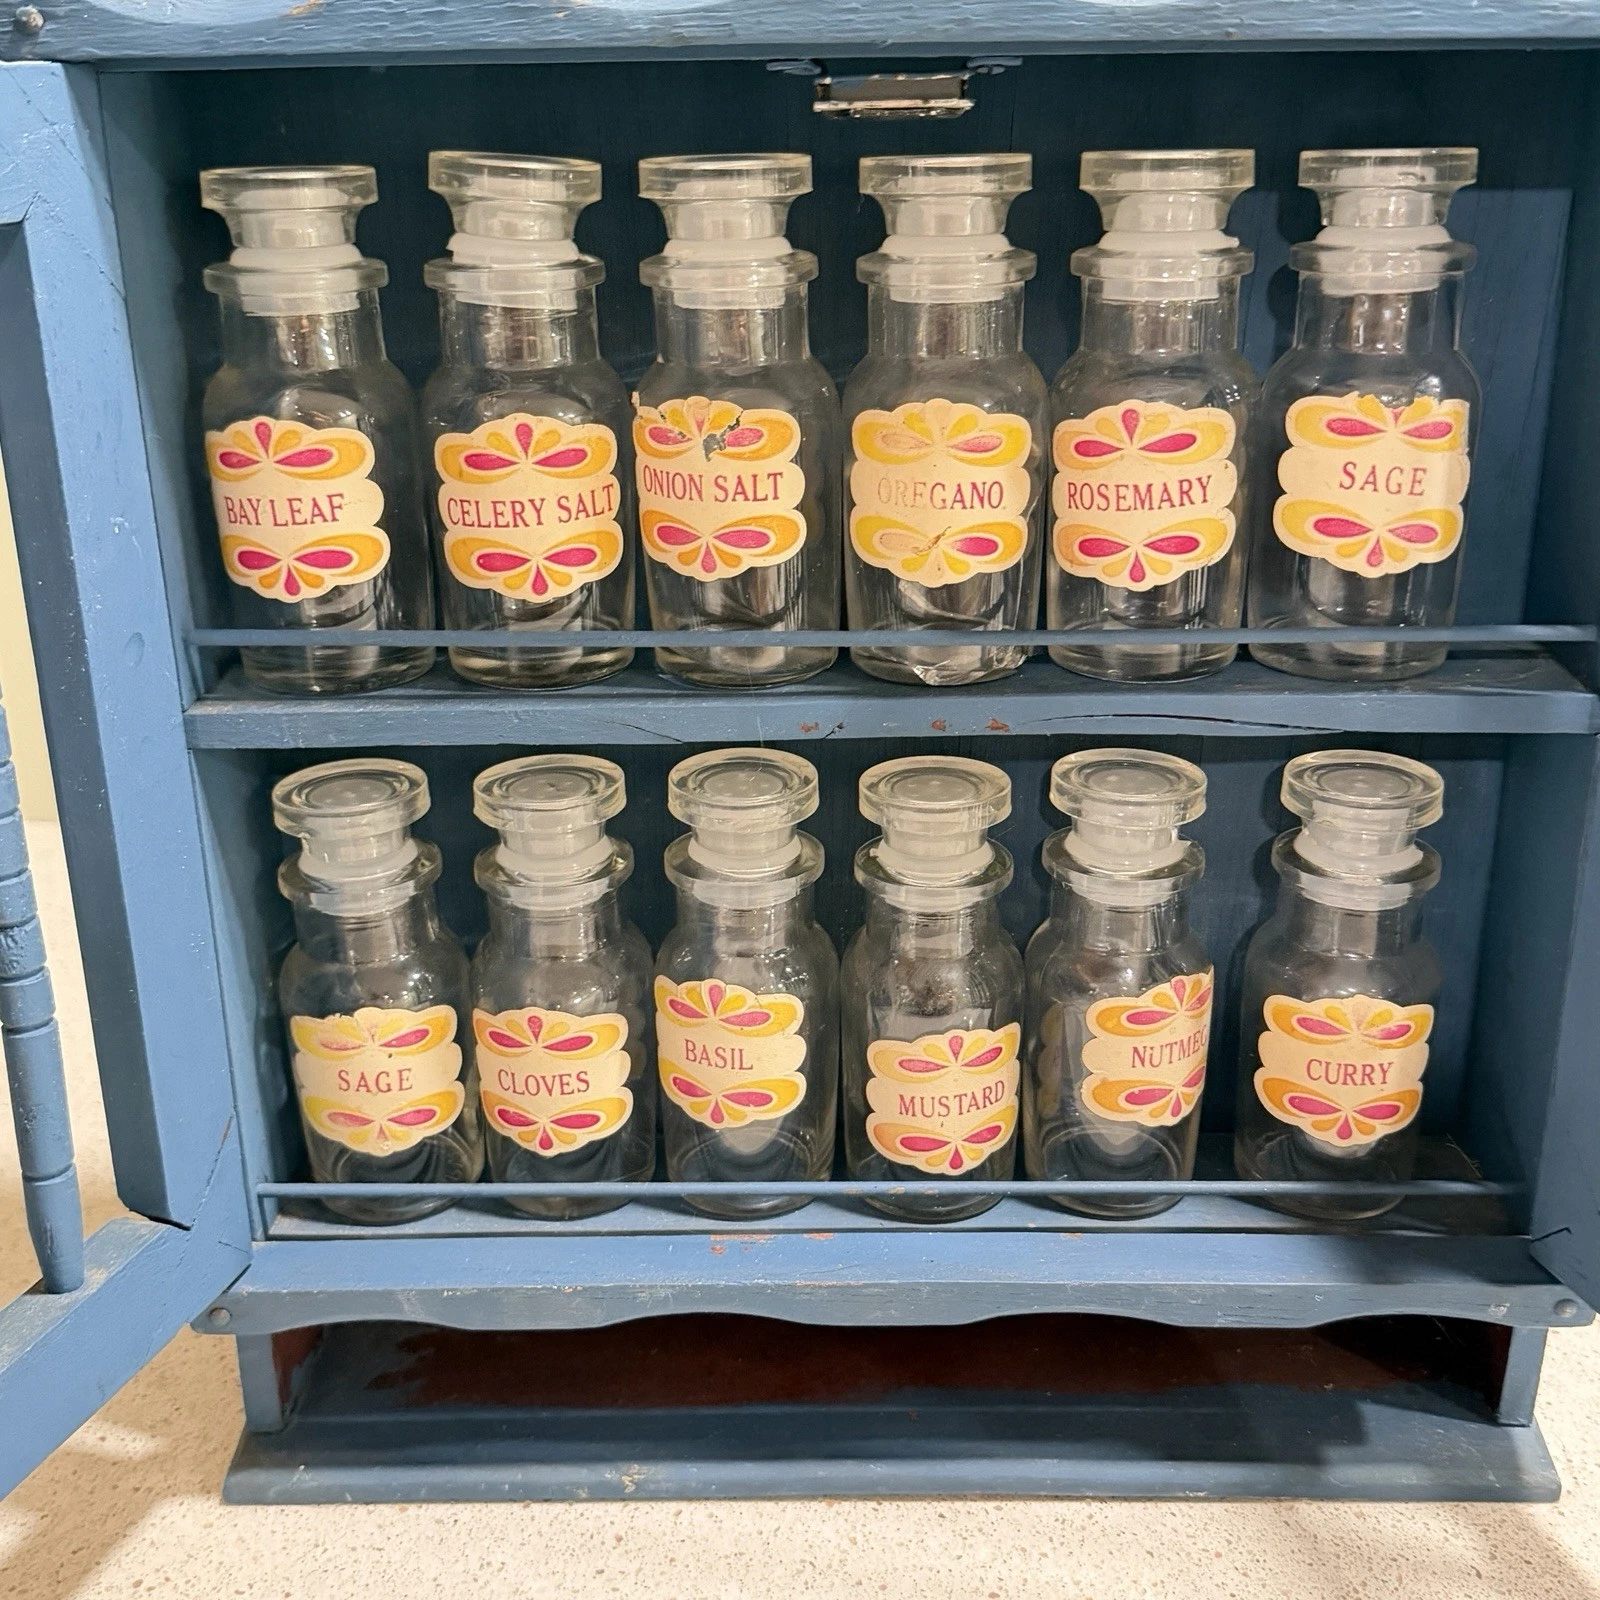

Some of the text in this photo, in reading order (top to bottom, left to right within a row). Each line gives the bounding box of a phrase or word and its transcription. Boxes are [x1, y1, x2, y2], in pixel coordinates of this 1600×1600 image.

[643, 464, 784, 504] ONION SALT
[877, 470, 1004, 511] OREGANO
[1067, 475, 1212, 512] ROSEMARY
[1339, 461, 1428, 496] SAGE
[223, 493, 345, 528] BAY LEAF
[447, 483, 616, 529] CELERY SALT
[684, 1039, 754, 1071] BASIL
[1305, 1058, 1394, 1086] CURRY
[337, 1068, 413, 1093] SAGE
[497, 1069, 591, 1097] CLOVES
[898, 1080, 1005, 1118] MUSTARD
